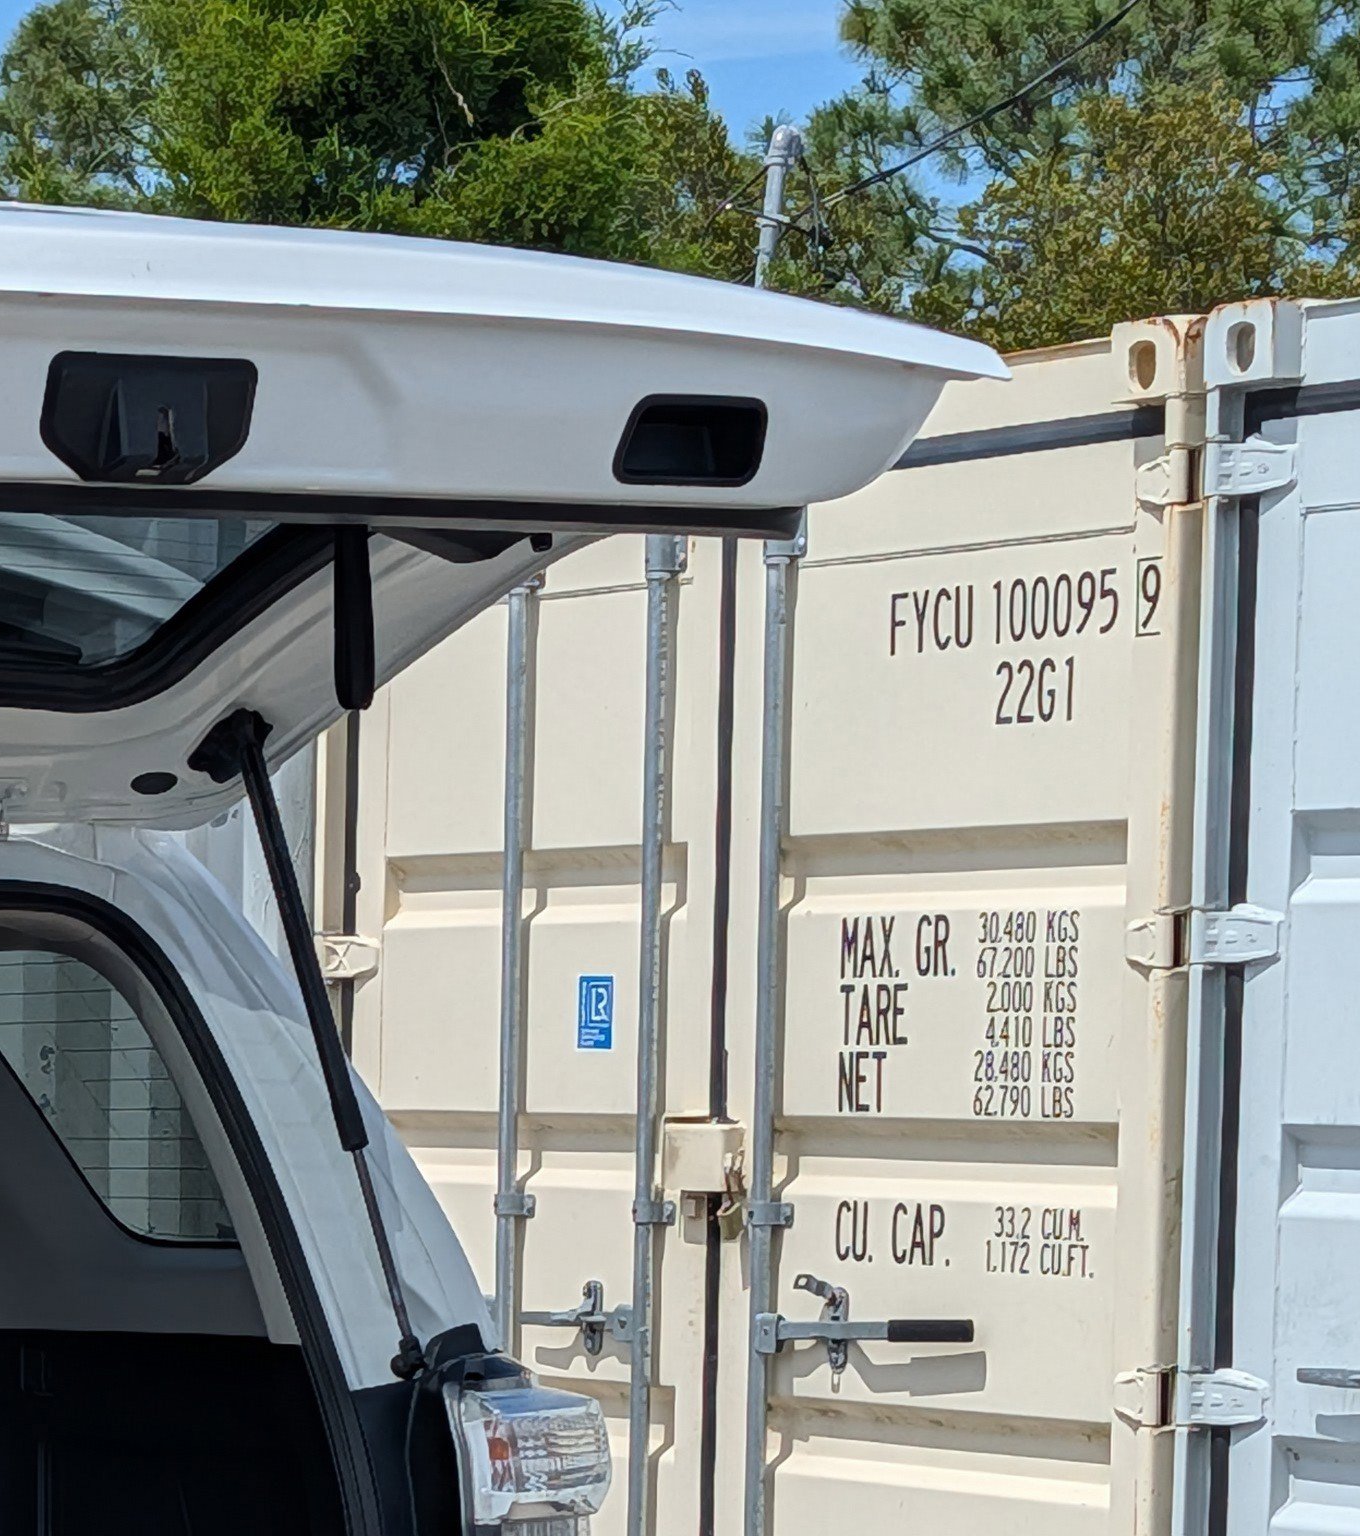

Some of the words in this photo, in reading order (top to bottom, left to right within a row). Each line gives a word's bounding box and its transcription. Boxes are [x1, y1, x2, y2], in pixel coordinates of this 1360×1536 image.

[890, 584, 974, 657] FYCU
[993, 567, 1119, 644] 100095
[1139, 563, 1162, 630] 9
[995, 655, 1074, 725] 22G1
[840, 915, 901, 980] MAX.
[915, 914, 956, 977] GR.
[1046, 910, 1080, 943] KGS
[1045, 945, 1079, 978] LBS
[840, 982, 908, 1046] TARE
[1043, 981, 1077, 1013] KGS
[1042, 1016, 1076, 1048] LBS
[838, 1051, 887, 1113] NET
[1041, 1050, 1075, 1083] KGS
[1041, 1086, 1074, 1118] LBS
[835, 1200, 873, 1263] CU.
[891, 1202, 951, 1267] CAP.
